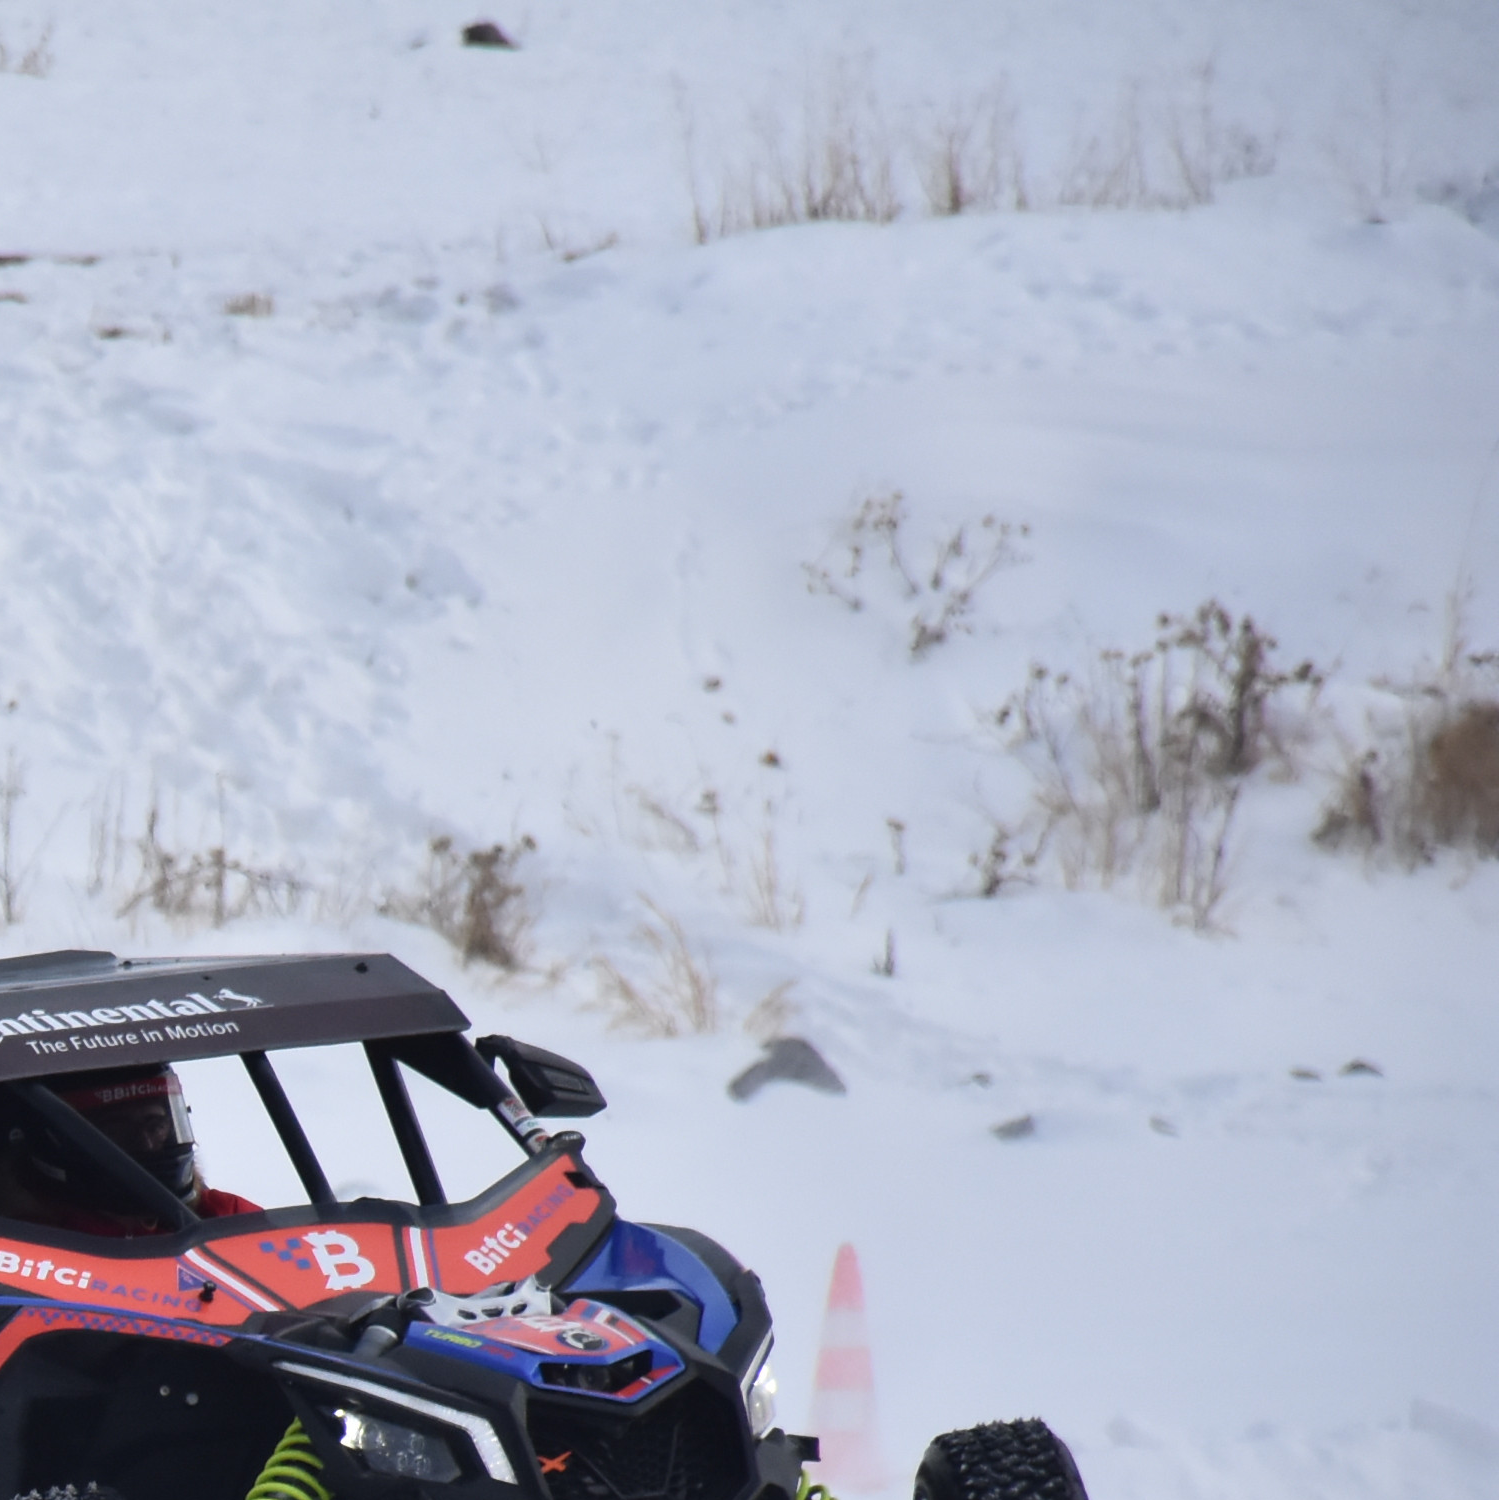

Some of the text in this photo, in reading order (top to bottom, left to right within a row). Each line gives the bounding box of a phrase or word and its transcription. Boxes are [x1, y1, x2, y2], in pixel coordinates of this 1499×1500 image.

[26, 1019, 240, 1056] The Future in Motion
